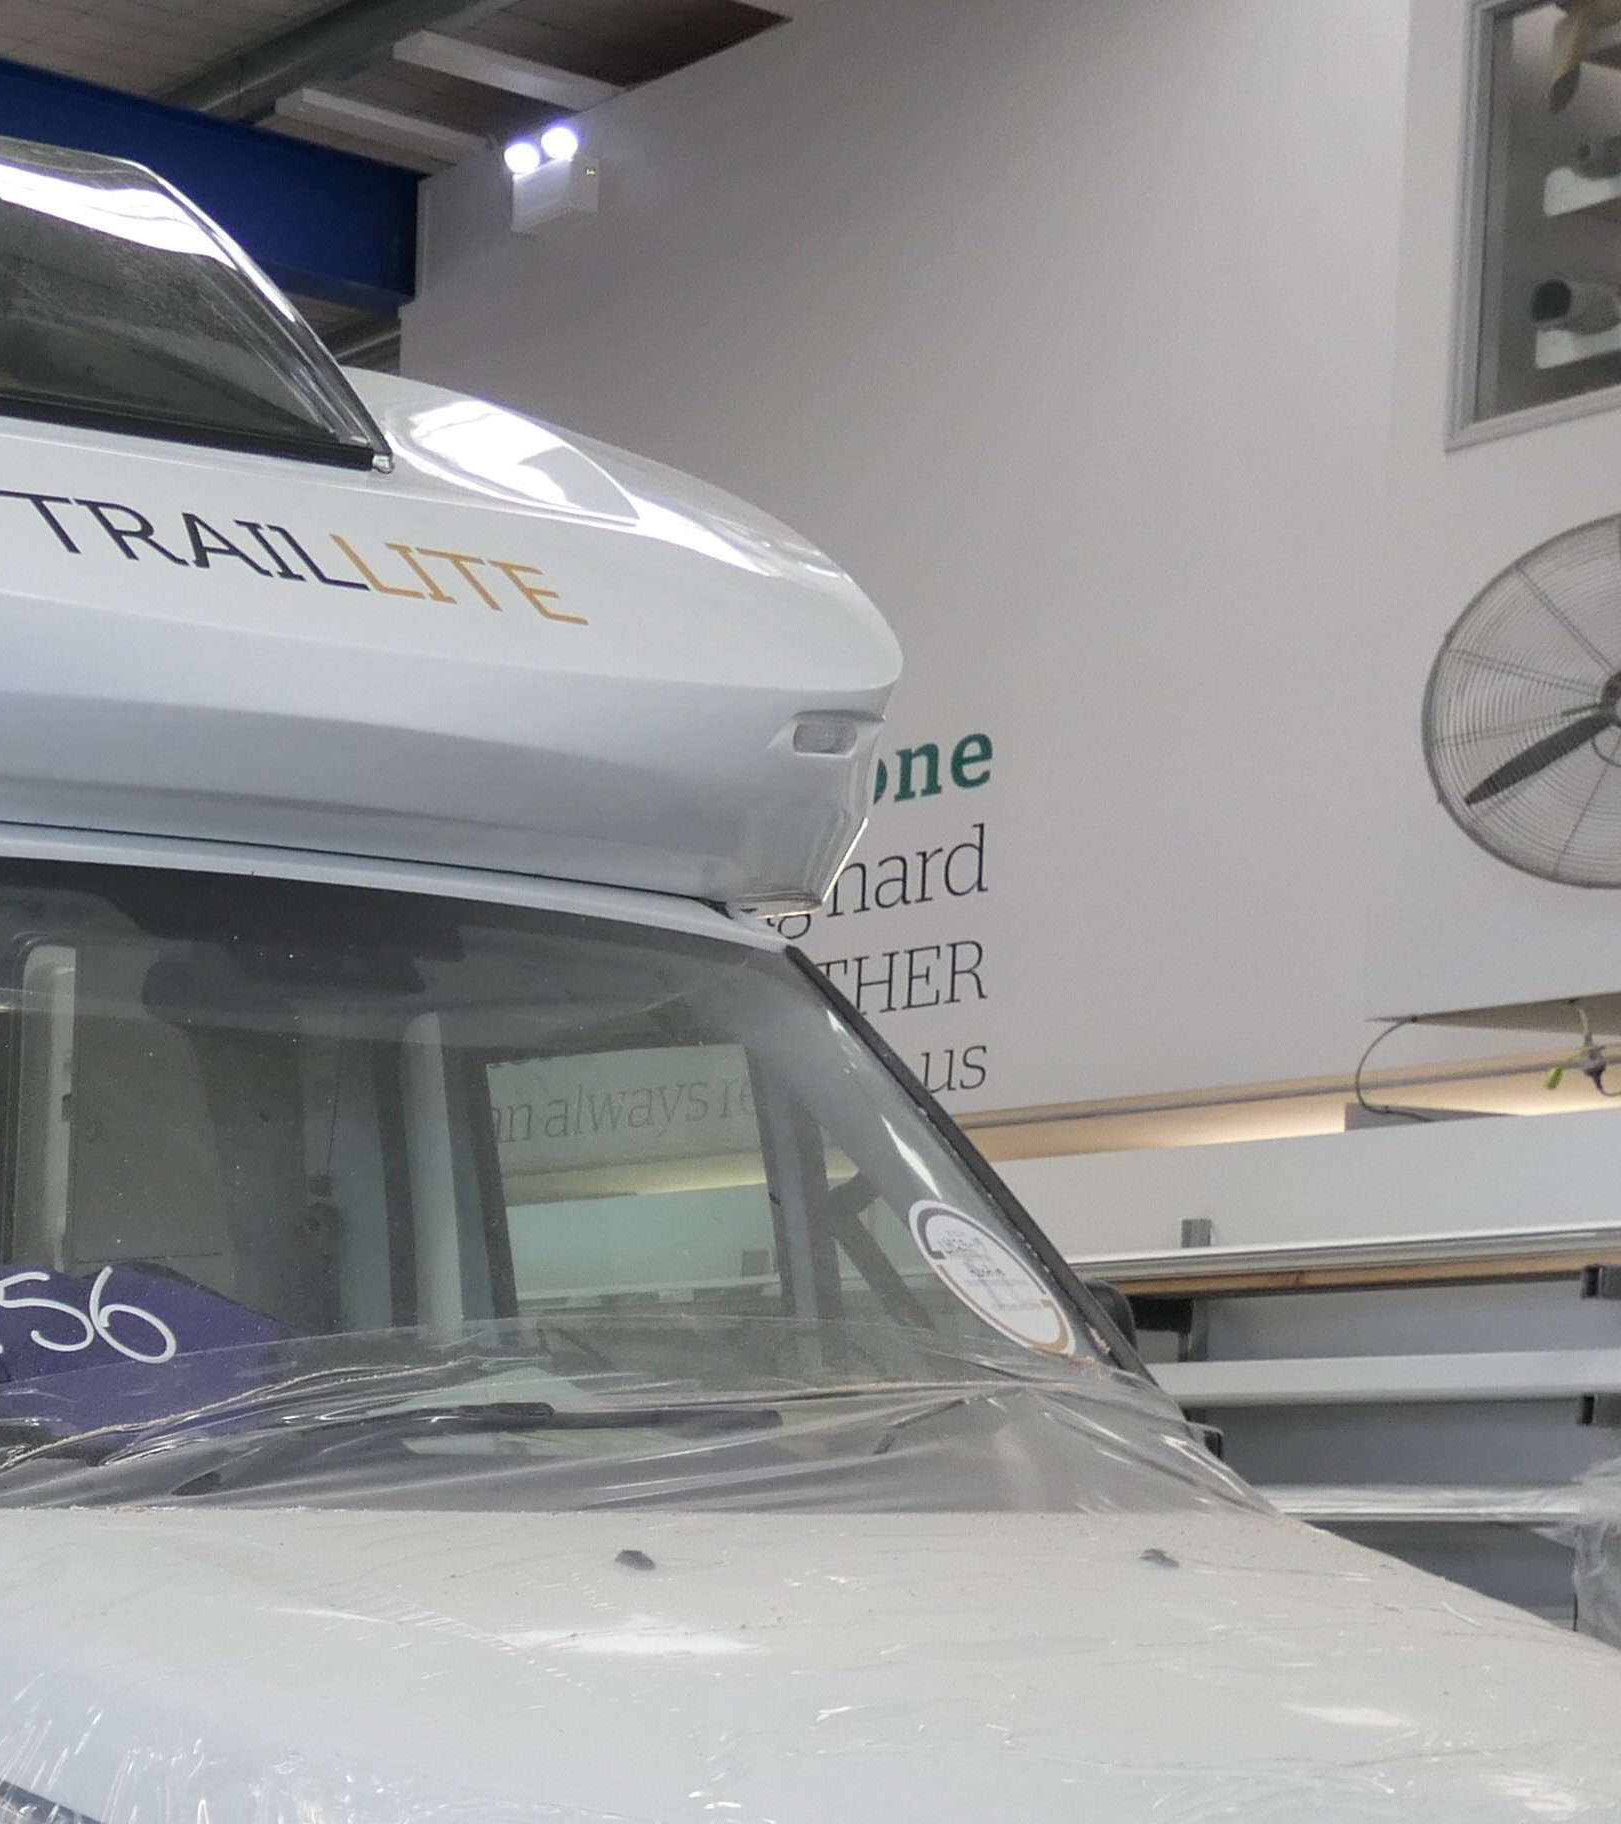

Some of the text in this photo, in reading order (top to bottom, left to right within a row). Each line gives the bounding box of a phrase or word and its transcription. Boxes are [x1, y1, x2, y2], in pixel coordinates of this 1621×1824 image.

[491, 1100, 534, 1143] n
[544, 1081, 708, 1140] always
[921, 1044, 988, 1095] us
